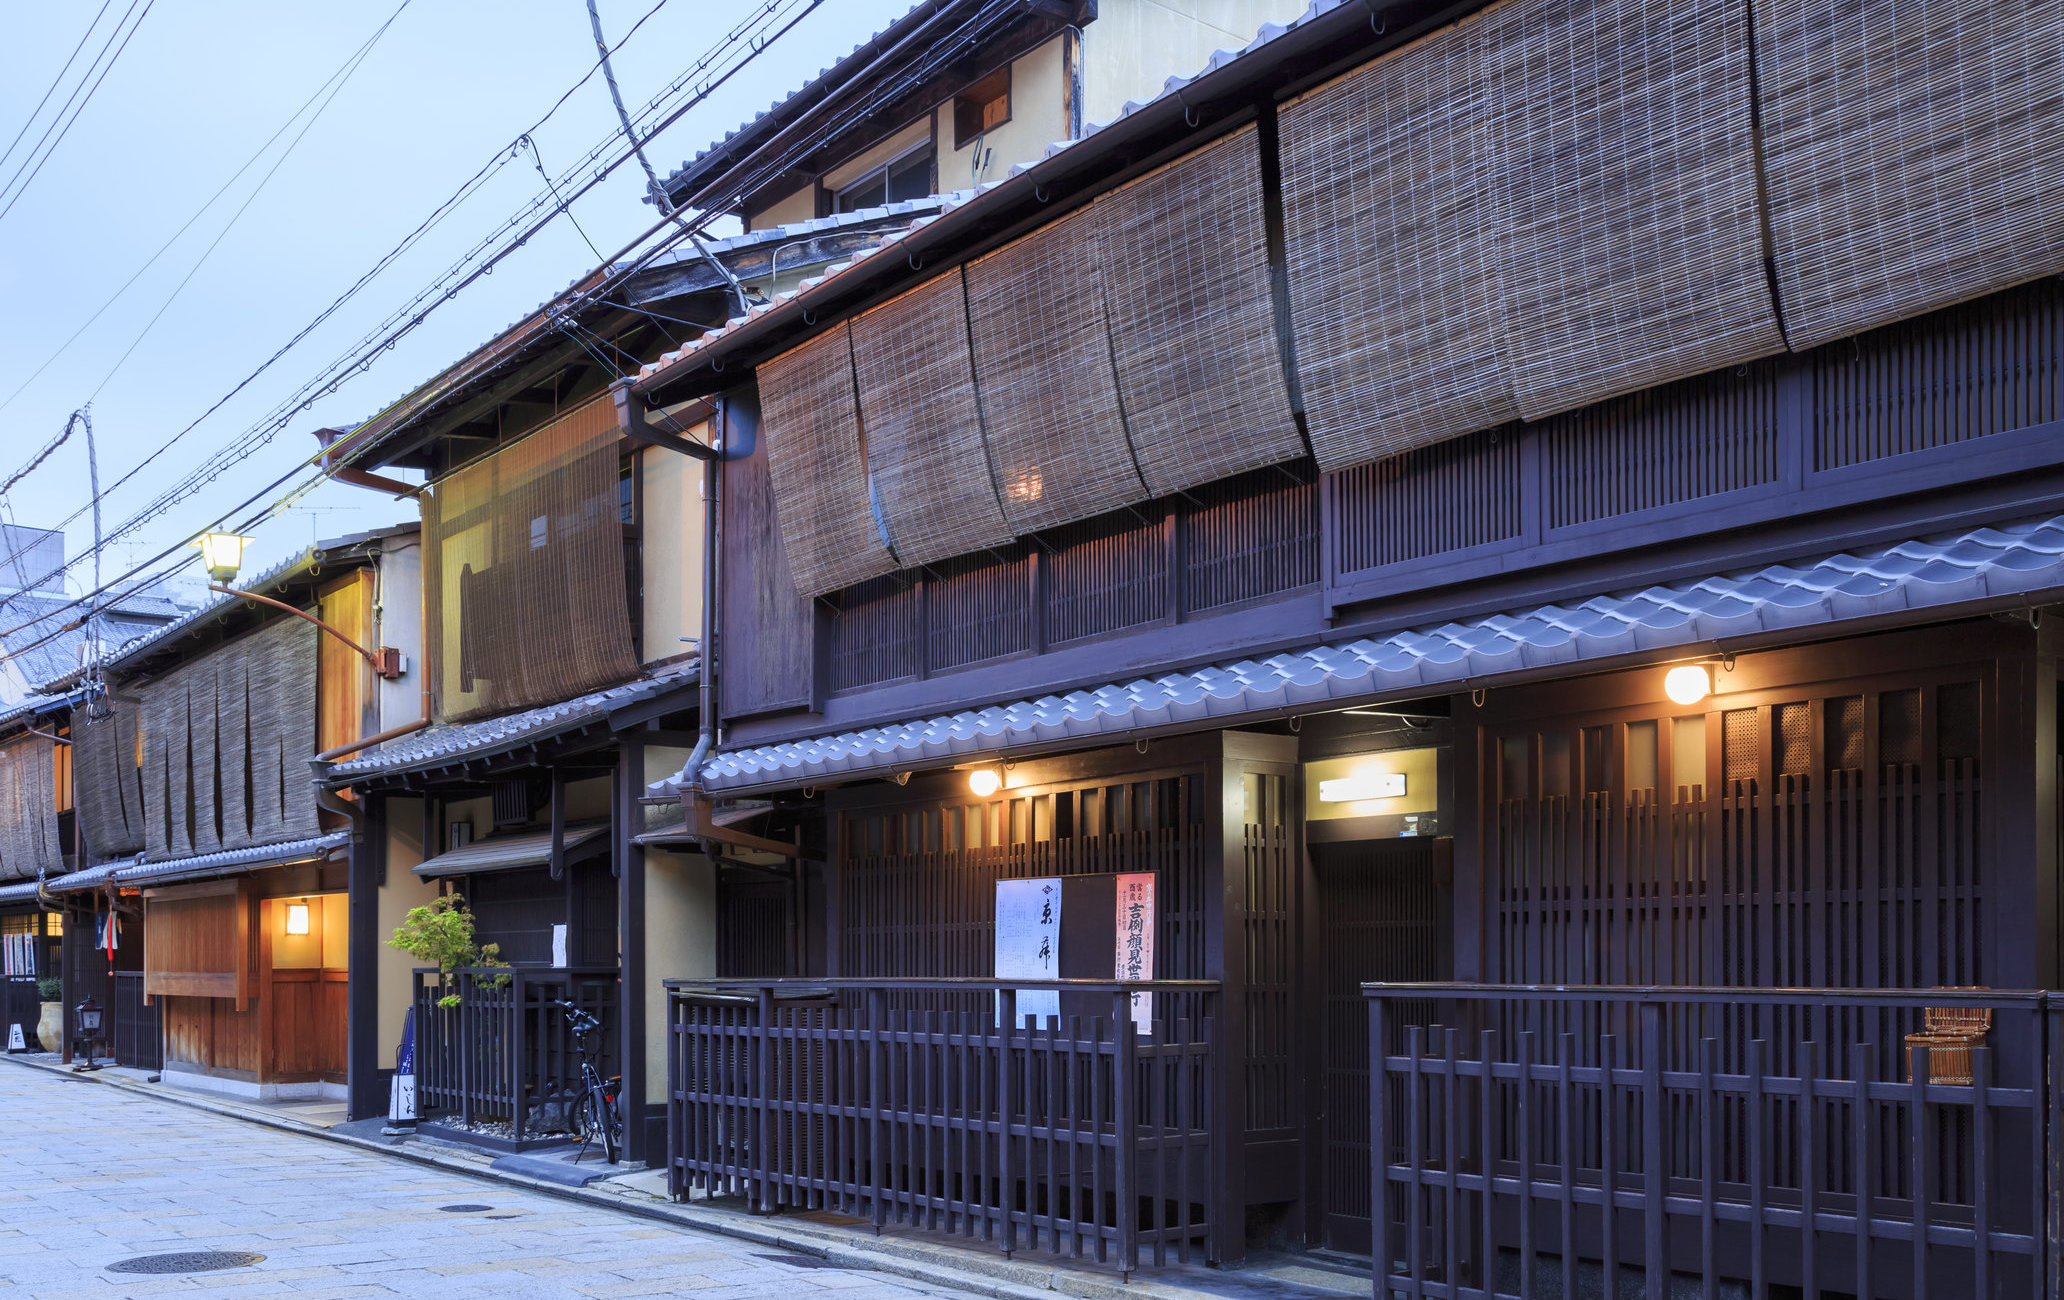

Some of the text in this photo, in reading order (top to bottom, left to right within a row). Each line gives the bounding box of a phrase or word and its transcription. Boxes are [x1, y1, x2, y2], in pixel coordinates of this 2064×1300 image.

[1126, 902, 1144, 1007] 吉例顔見世行
